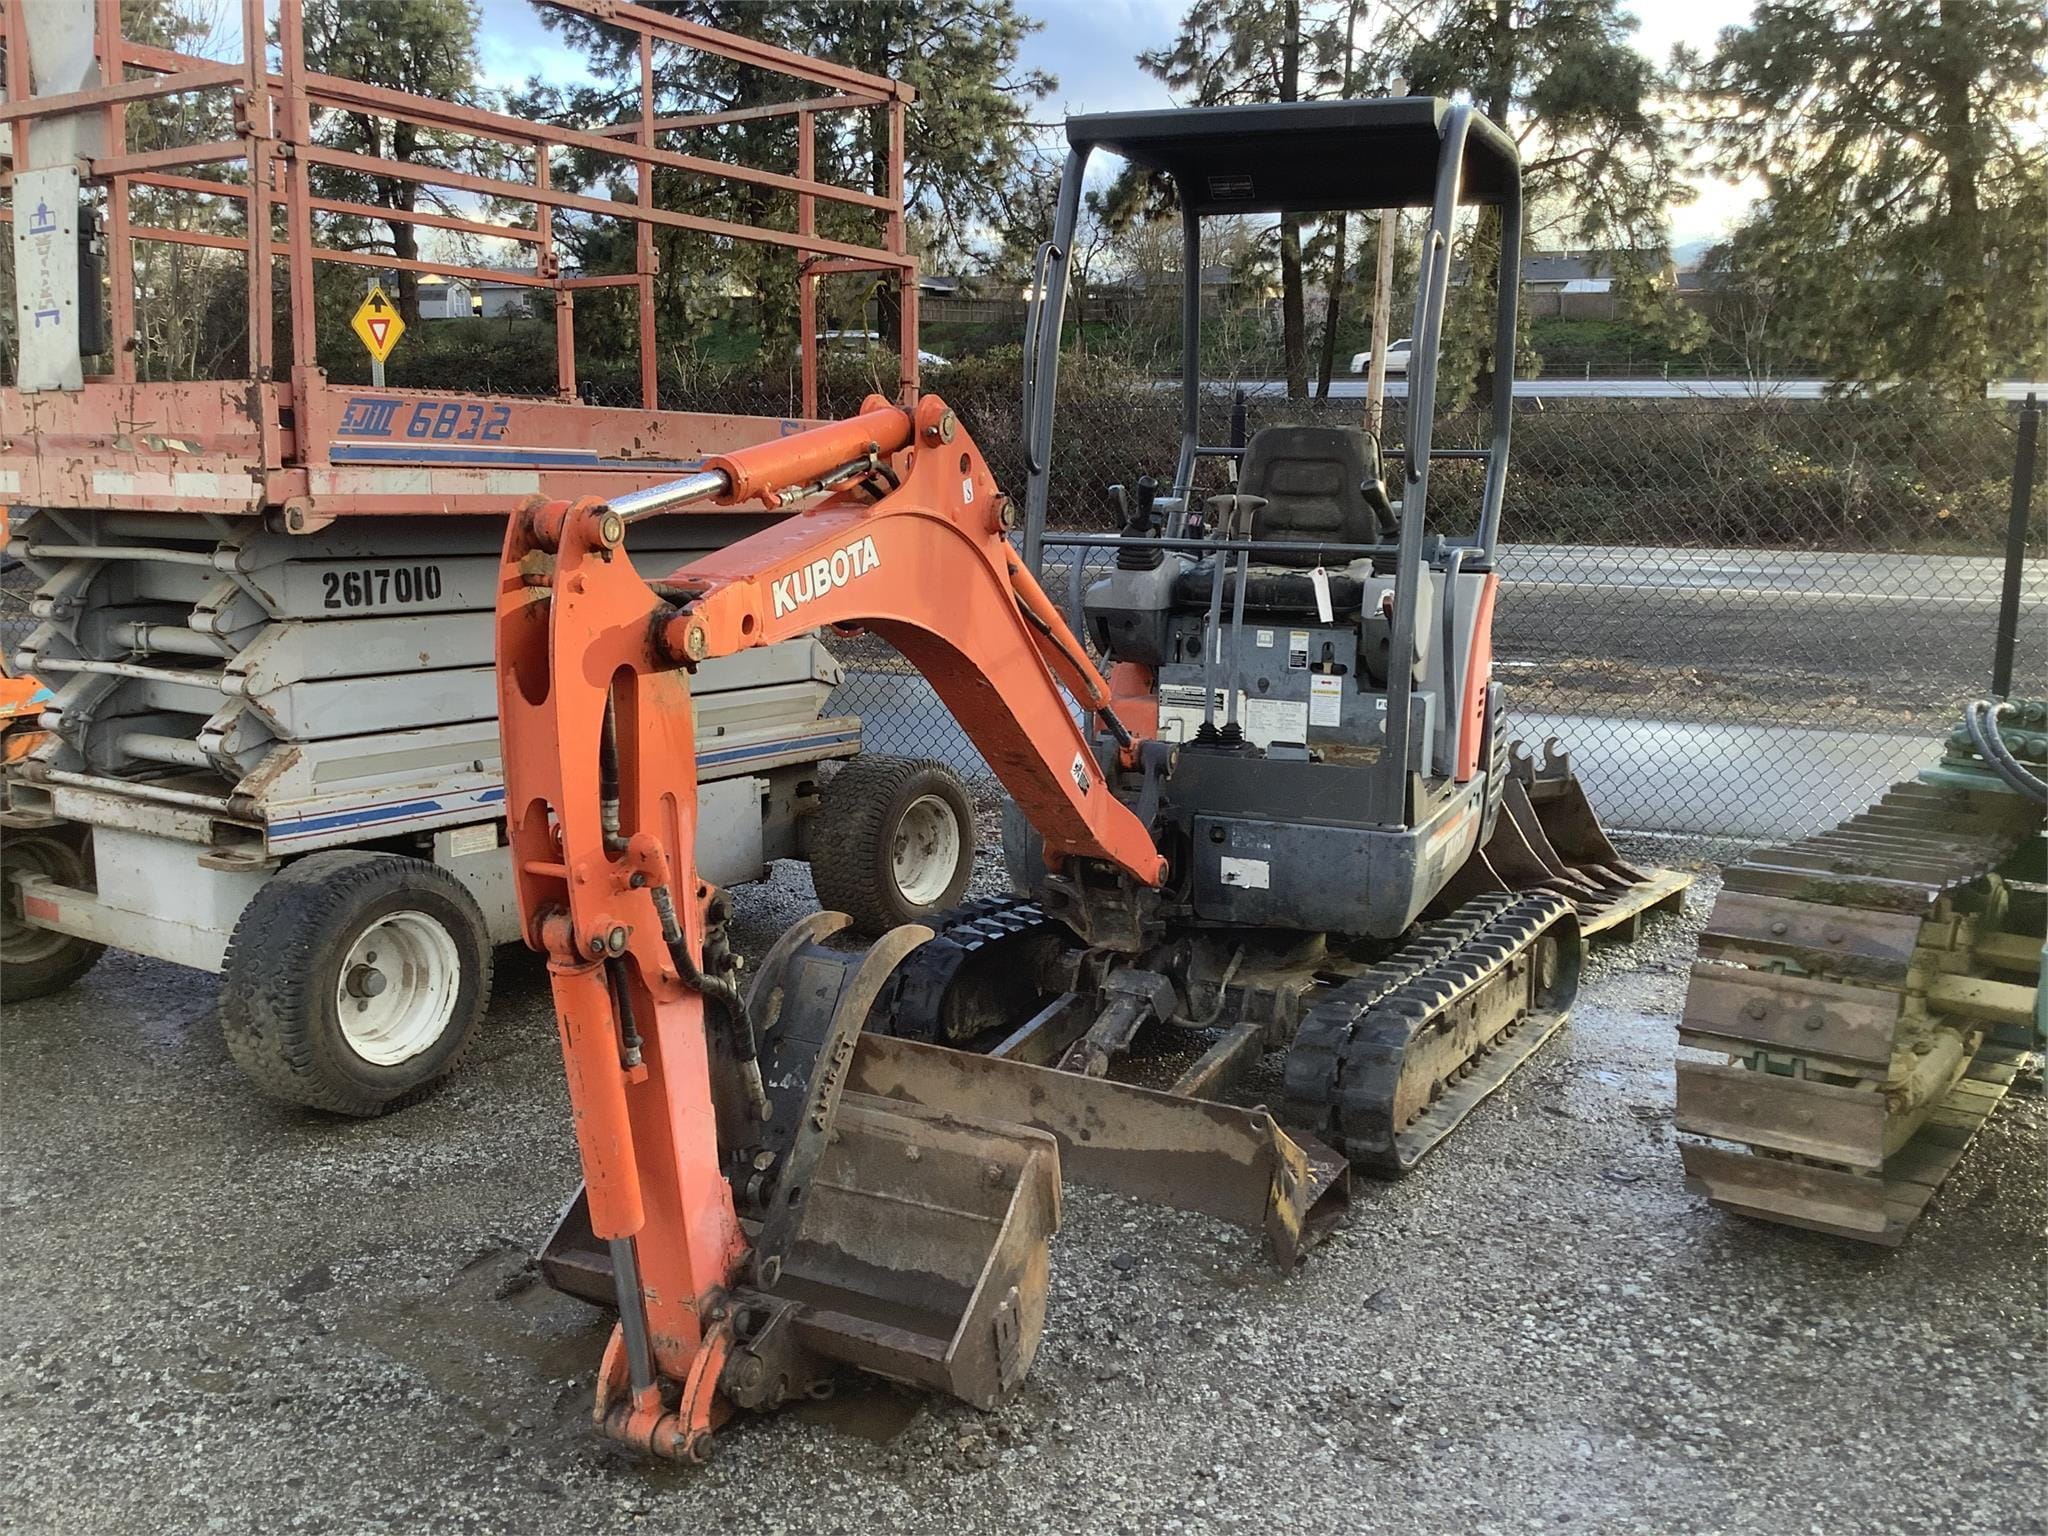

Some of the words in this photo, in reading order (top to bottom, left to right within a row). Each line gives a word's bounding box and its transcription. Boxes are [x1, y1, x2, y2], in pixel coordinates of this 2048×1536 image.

[406, 402, 512, 441] 6832
[322, 565, 441, 609] 2617010
[771, 534, 881, 620] KUBOTA
